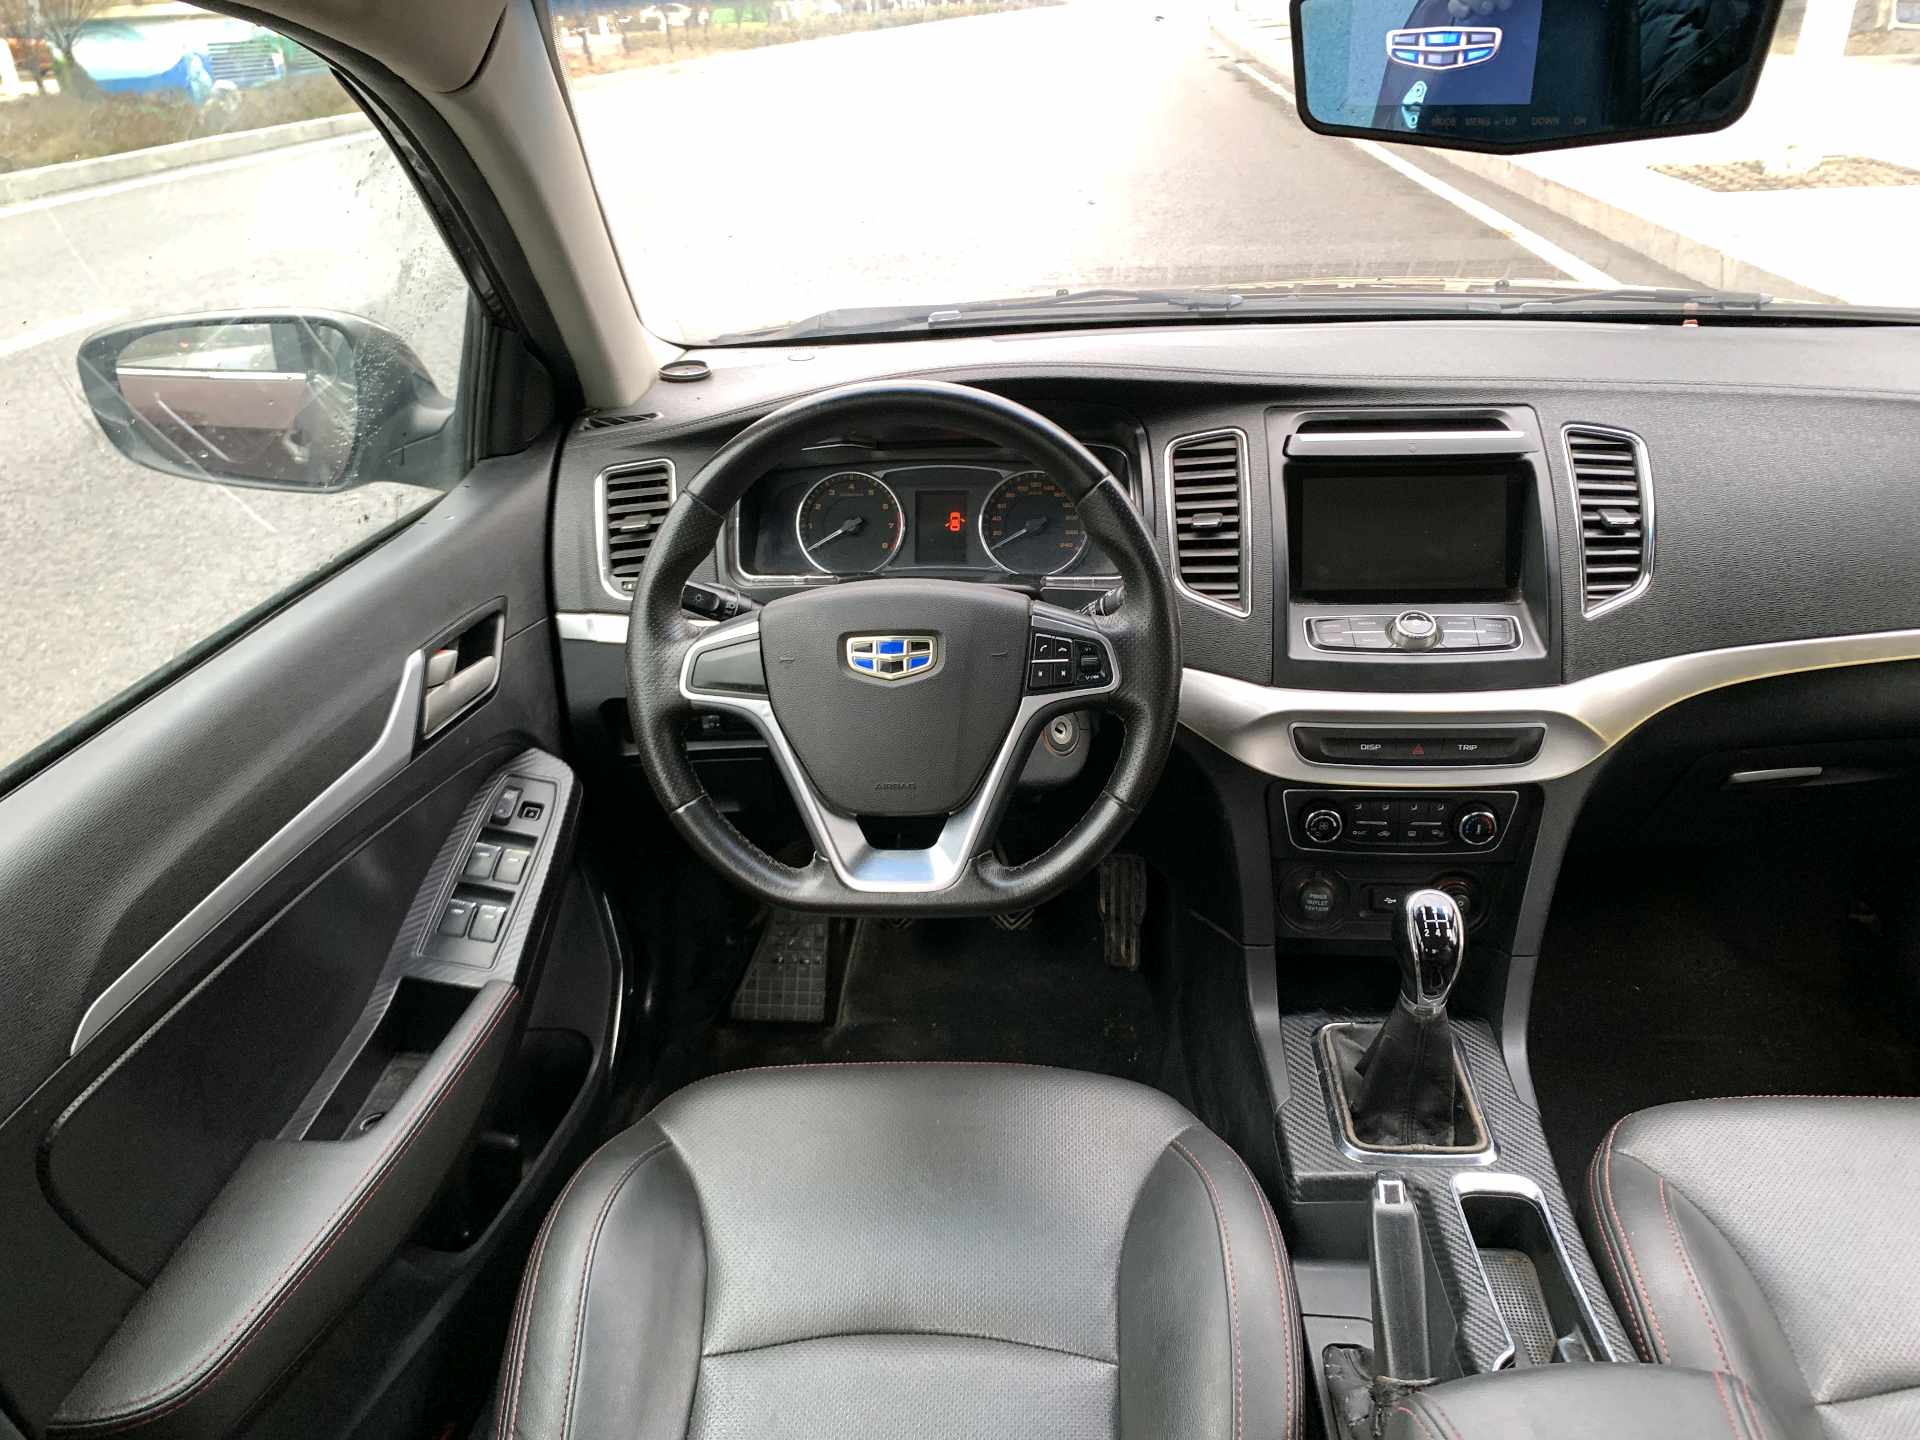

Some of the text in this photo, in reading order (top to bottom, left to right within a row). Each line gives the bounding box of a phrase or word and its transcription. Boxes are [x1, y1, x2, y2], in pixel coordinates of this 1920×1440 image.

[1360, 743, 1382, 751] DISP
[1423, 928, 1430, 937] 2
[1435, 928, 1442, 937] 4
